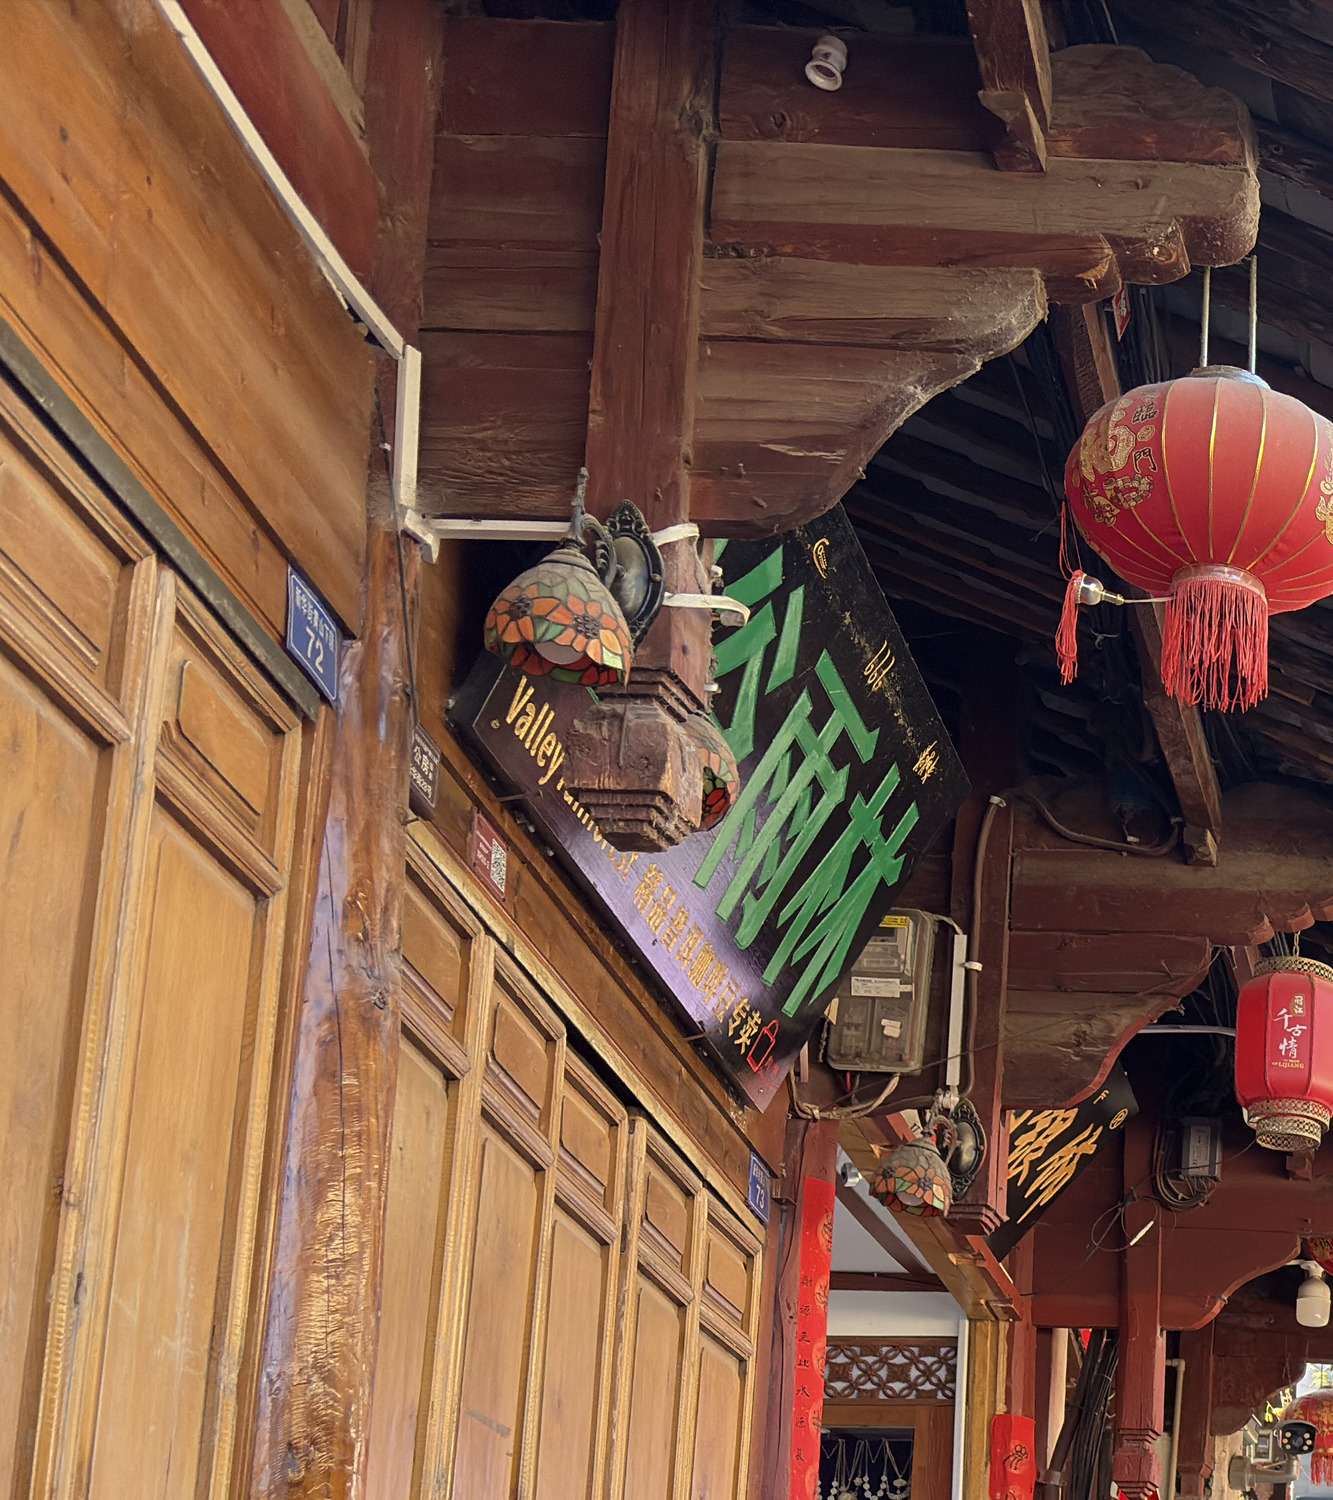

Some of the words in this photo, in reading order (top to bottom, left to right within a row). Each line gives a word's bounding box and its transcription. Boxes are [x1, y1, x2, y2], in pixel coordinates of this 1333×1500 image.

[305, 625, 324, 674] 72
[505, 674, 566, 786] Valley
[1272, 1007, 1308, 1059] 千古情
[756, 1184, 765, 1209] 73
